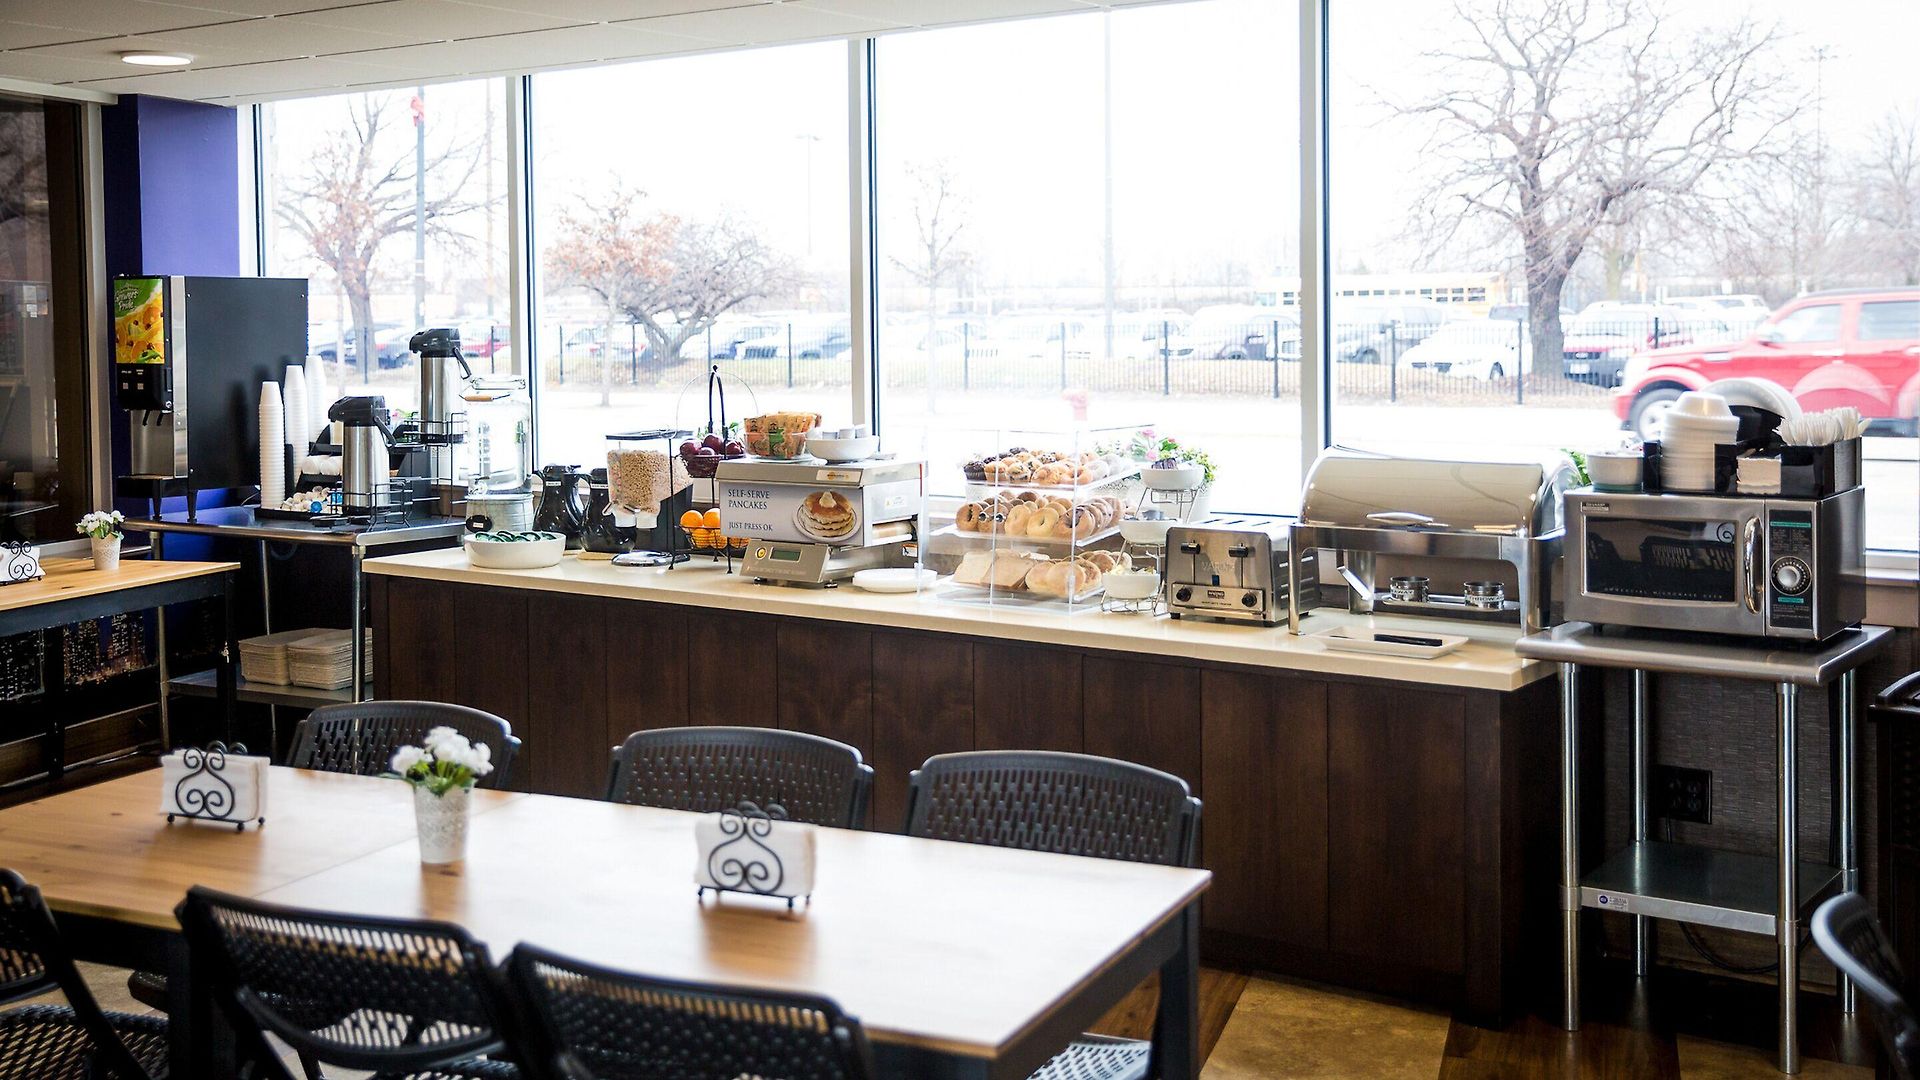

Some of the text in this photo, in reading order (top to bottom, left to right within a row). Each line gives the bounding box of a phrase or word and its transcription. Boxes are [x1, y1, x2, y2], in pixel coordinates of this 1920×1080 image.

[728, 489, 770, 499] SELF-SERVE
[728, 500, 767, 510] PANCAKES
[728, 521, 742, 529] JUST
[763, 523, 773, 531] OK
